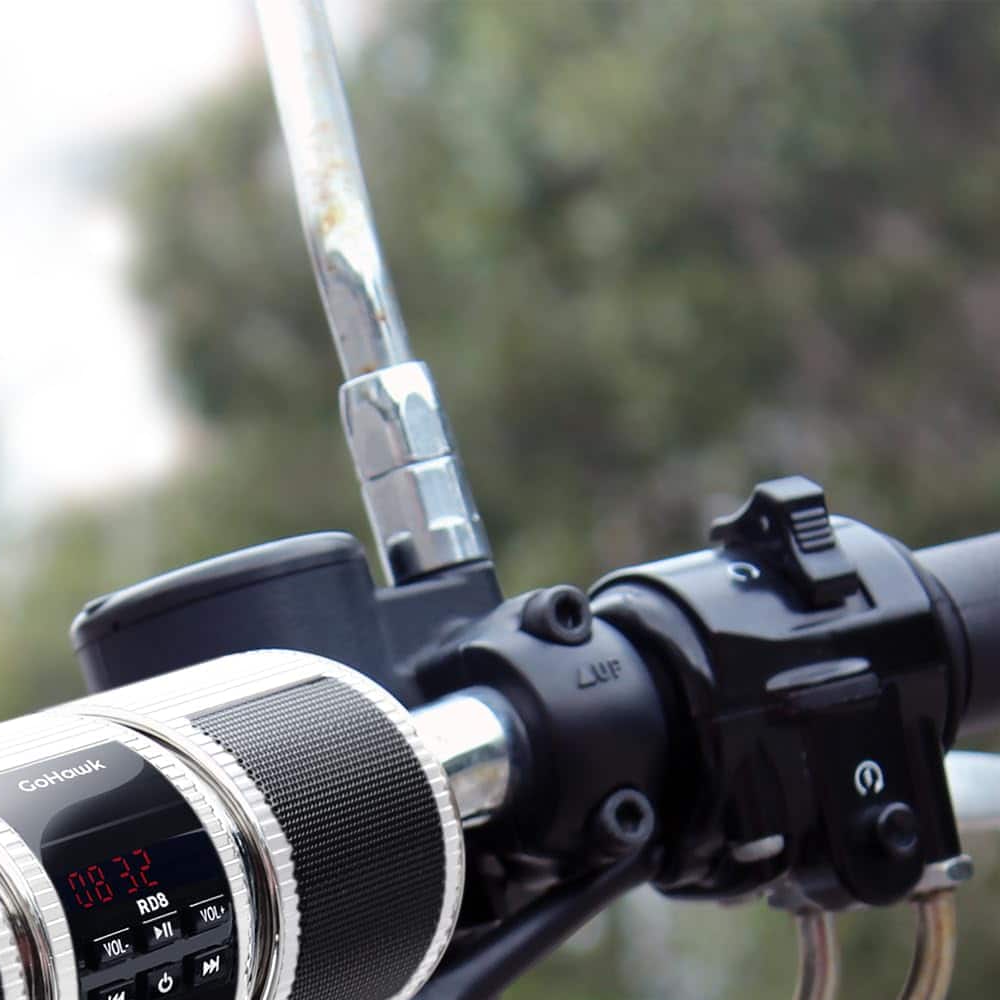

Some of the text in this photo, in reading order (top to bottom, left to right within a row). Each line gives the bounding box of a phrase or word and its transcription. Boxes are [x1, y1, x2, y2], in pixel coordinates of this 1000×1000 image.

[17, 758, 106, 793] GoHawk
[199, 905, 226, 923] VOL+
[103, 939, 130, 957] VOL-
